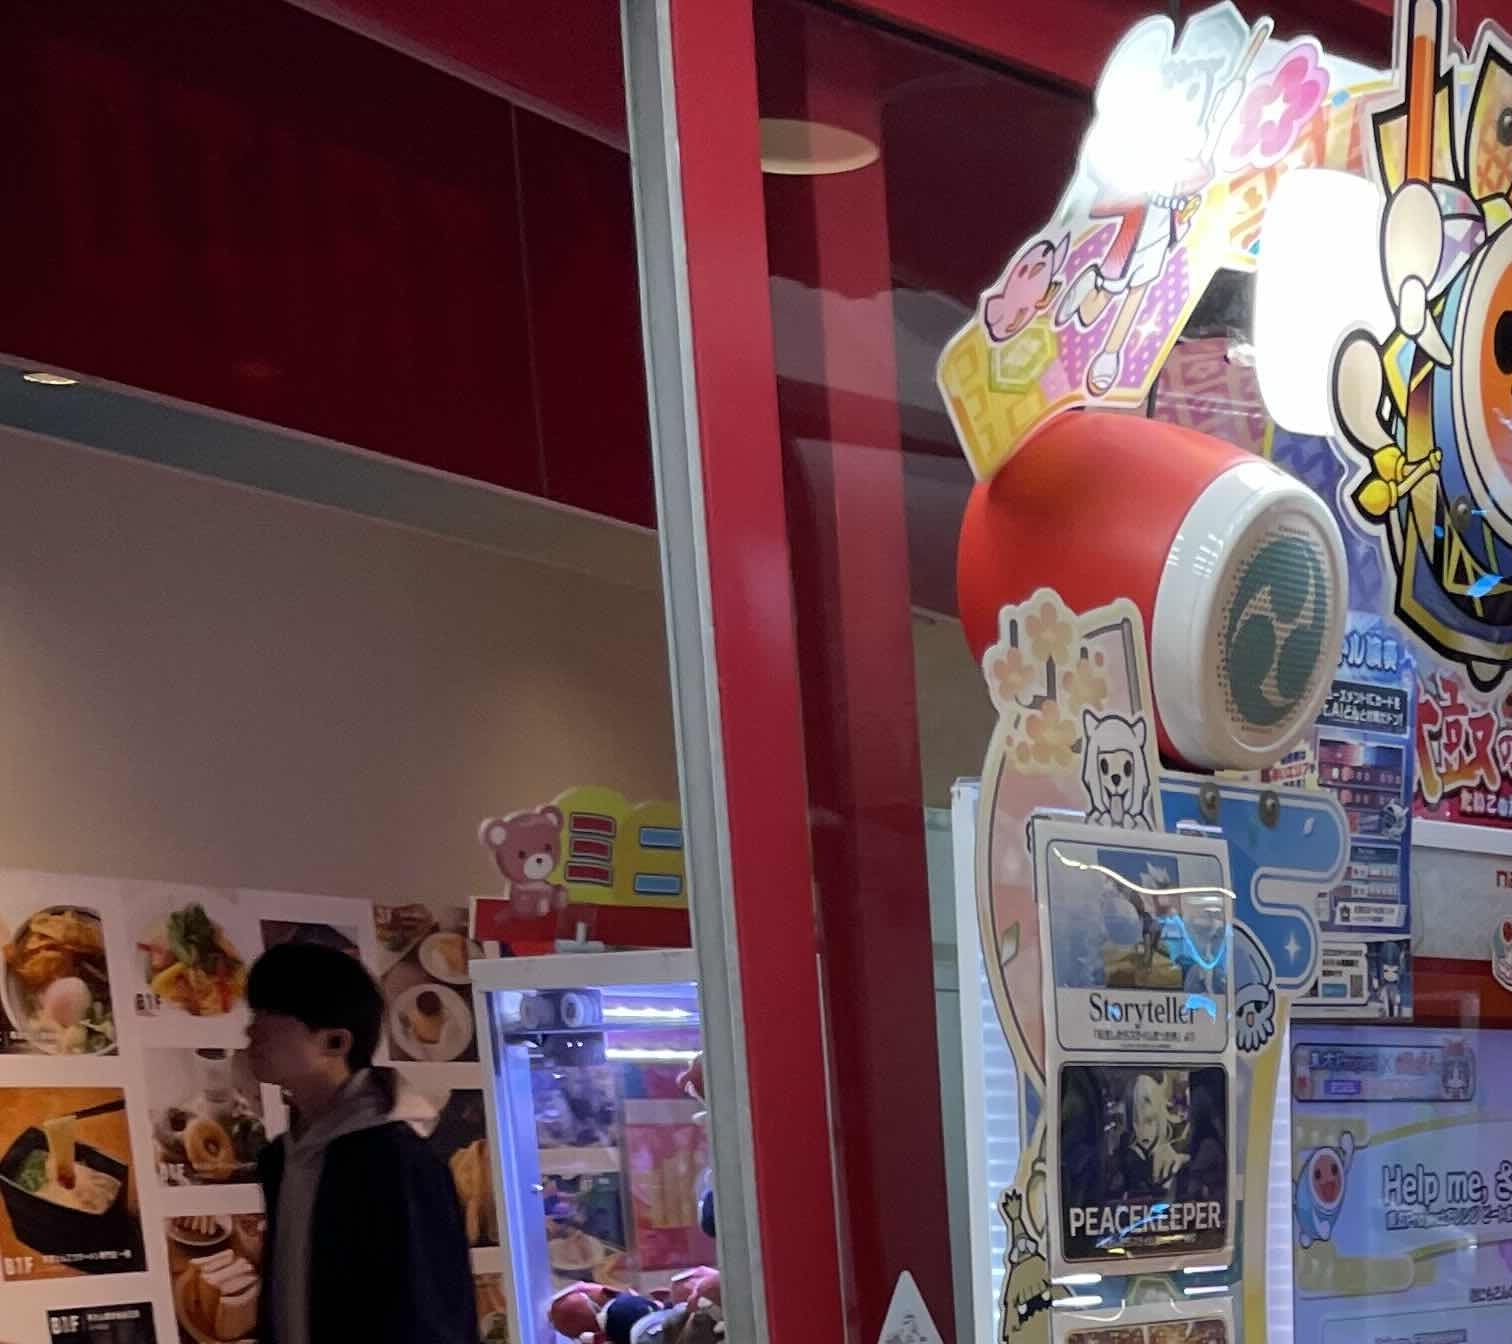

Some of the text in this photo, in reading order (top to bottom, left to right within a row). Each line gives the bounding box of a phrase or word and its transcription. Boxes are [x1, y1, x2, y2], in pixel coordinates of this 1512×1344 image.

[1089, 991, 1198, 1028] Storyteller
[1382, 1164, 1441, 1207] Help
[1069, 1202, 1222, 1237] PEACEKEEPER
